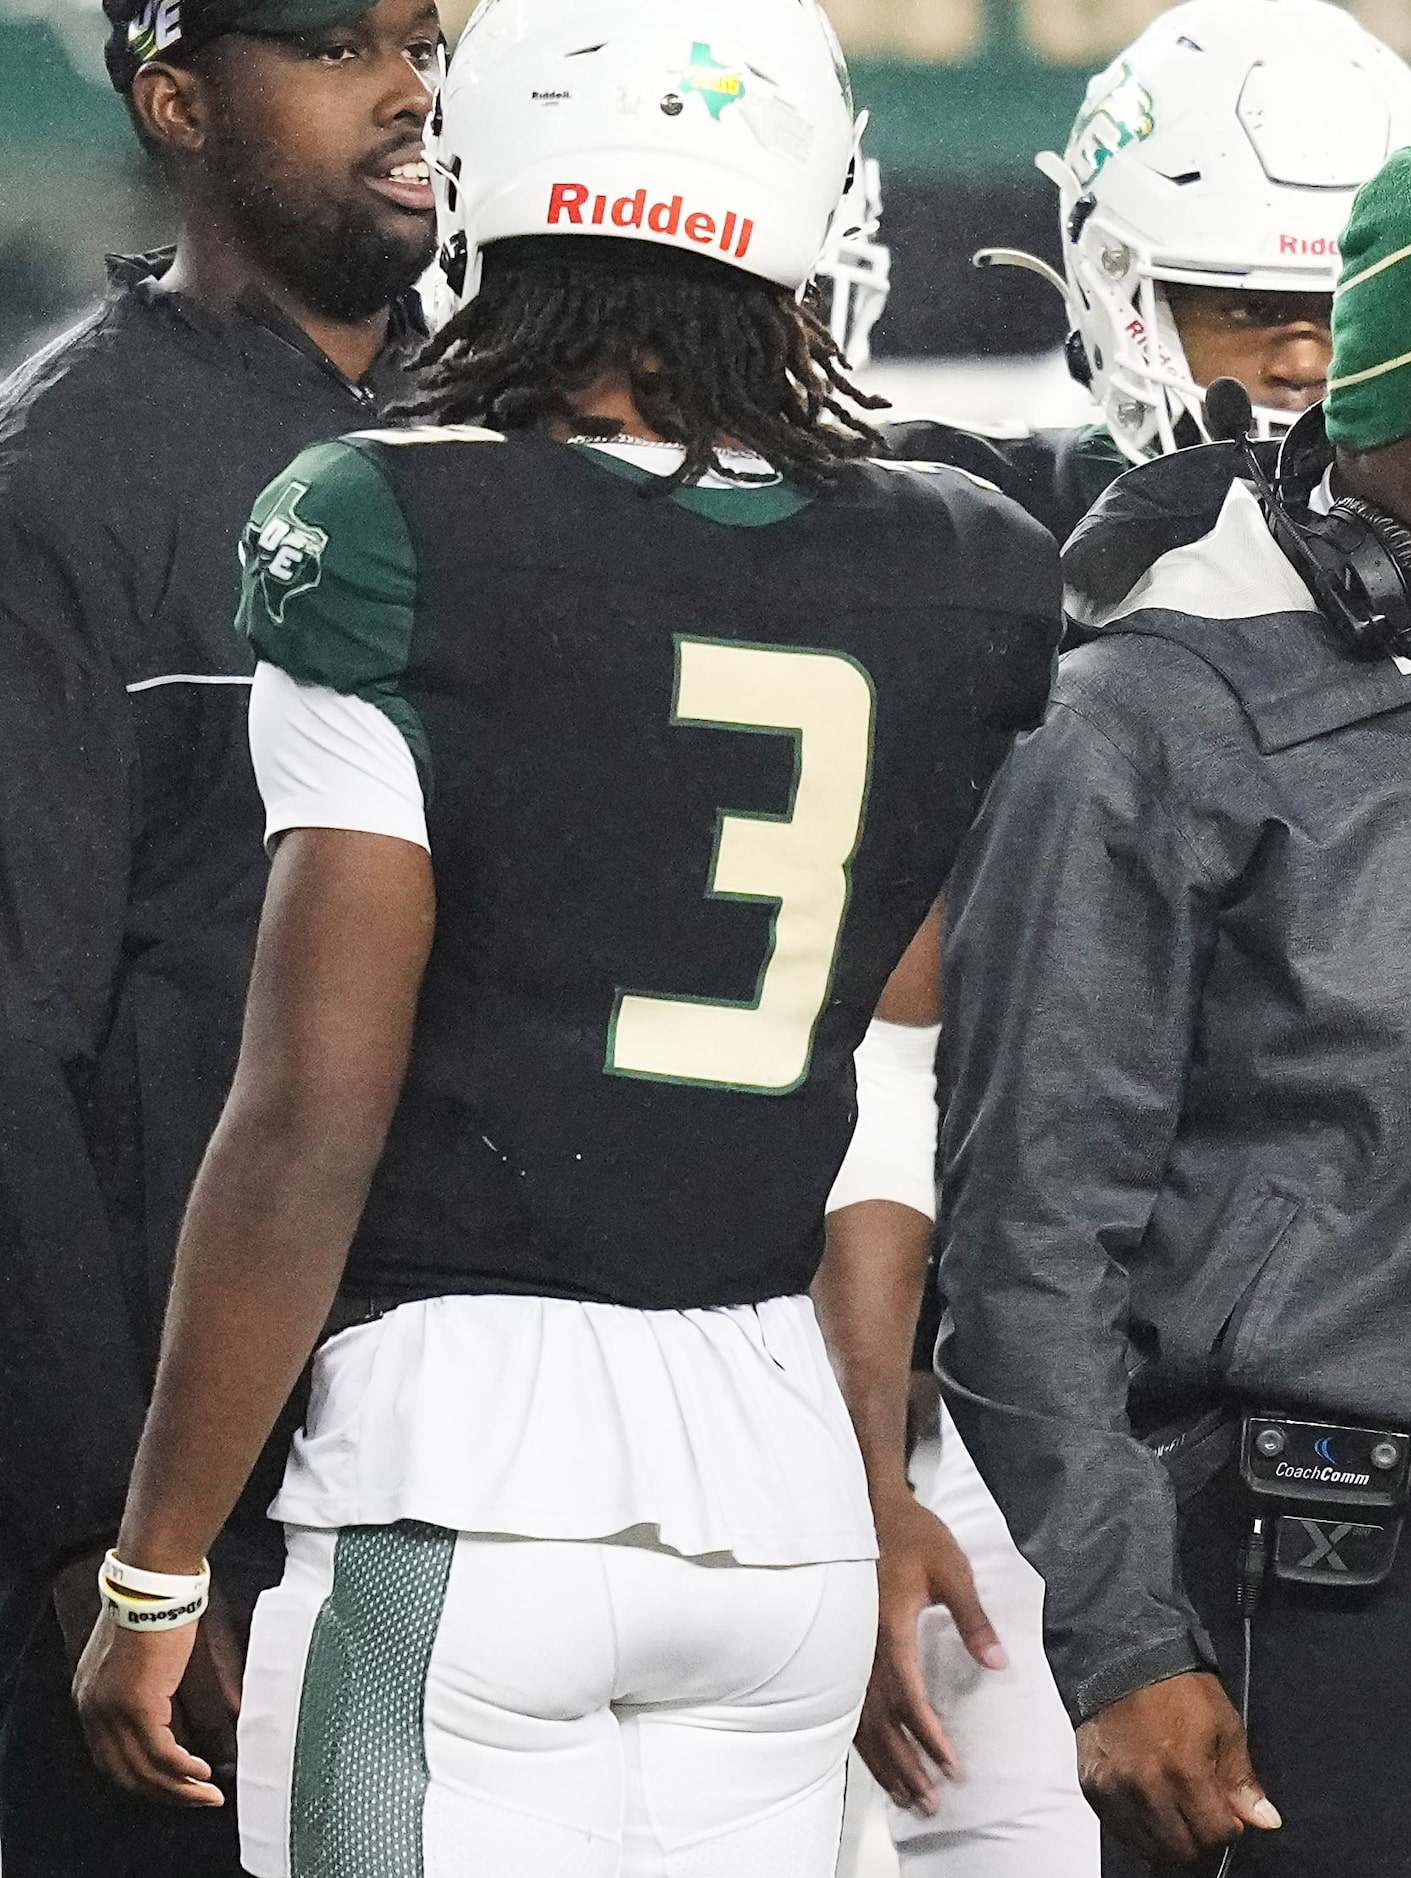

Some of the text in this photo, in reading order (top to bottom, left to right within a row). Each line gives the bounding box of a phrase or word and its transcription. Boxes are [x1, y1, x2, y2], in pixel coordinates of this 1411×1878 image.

[547, 183, 754, 258] Riddell
[604, 634, 877, 1095] 3
[1275, 1462, 1370, 1485] CoachComm
